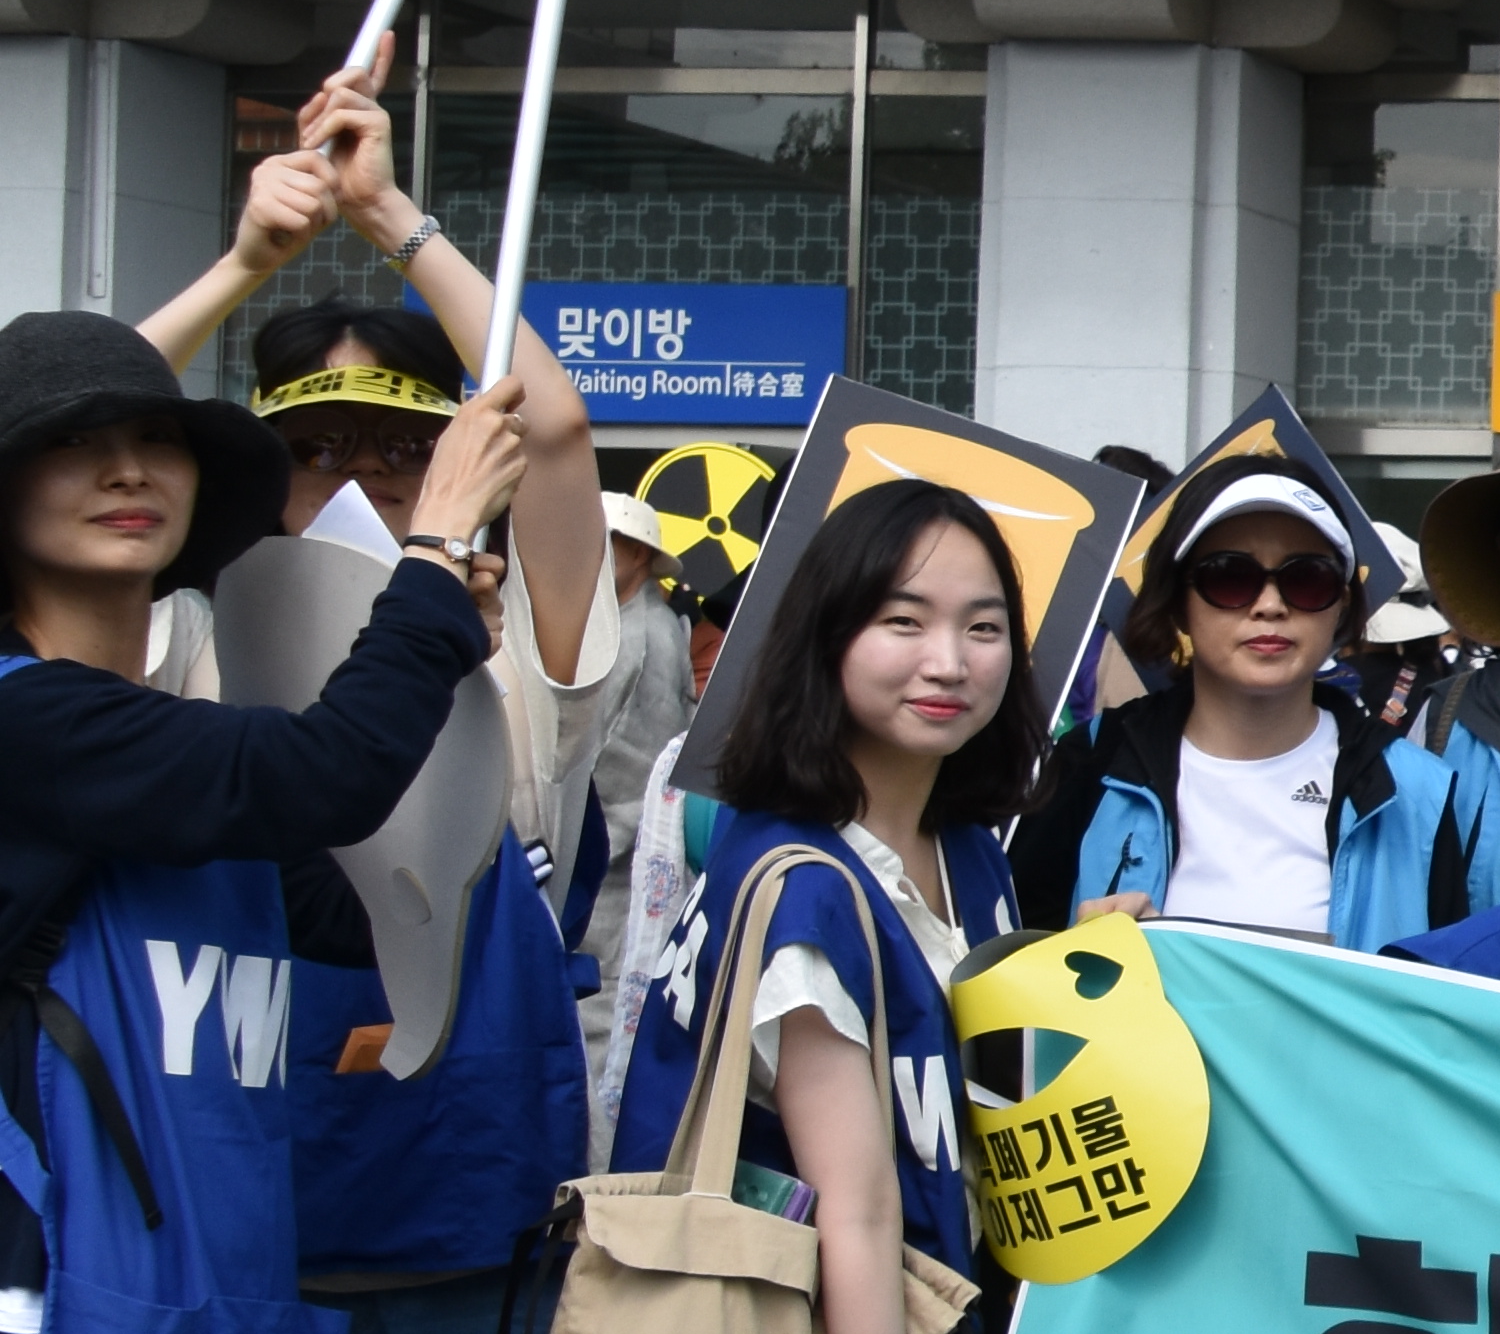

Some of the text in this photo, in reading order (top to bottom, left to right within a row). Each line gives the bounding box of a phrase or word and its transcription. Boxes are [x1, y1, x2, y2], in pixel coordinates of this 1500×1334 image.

[557, 307, 692, 361] 맞이방
[652, 370, 721, 395] Room
[732, 371, 805, 398] 待合室
[1290, 792, 1328, 805] adidas
[988, 1156, 1152, 1249] 이제그만
